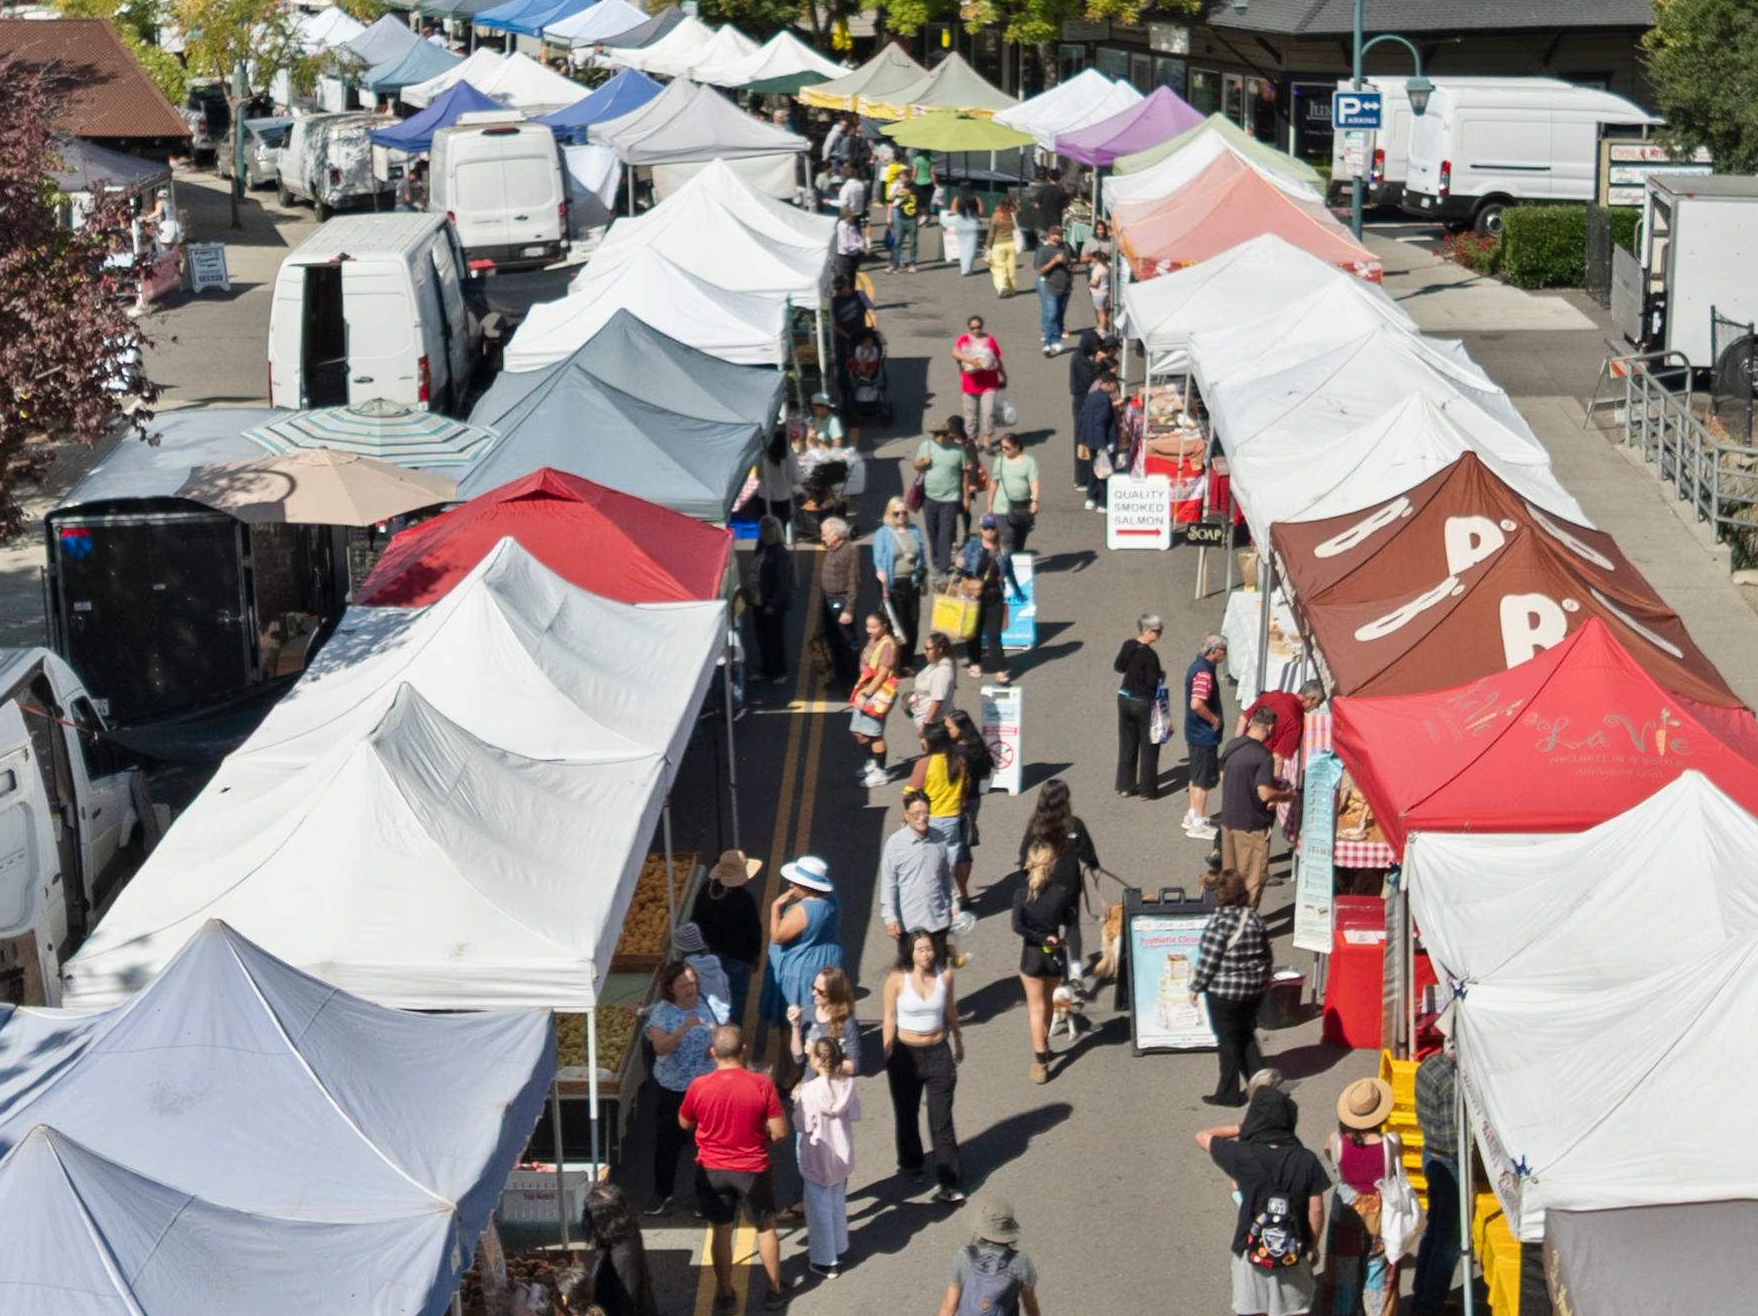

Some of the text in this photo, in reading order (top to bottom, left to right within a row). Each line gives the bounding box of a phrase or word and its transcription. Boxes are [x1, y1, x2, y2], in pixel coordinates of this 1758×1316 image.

[1114, 490, 1164, 500] QUALITY
[1114, 503, 1164, 513] SMOKED
[1114, 516, 1164, 525] SALMON
